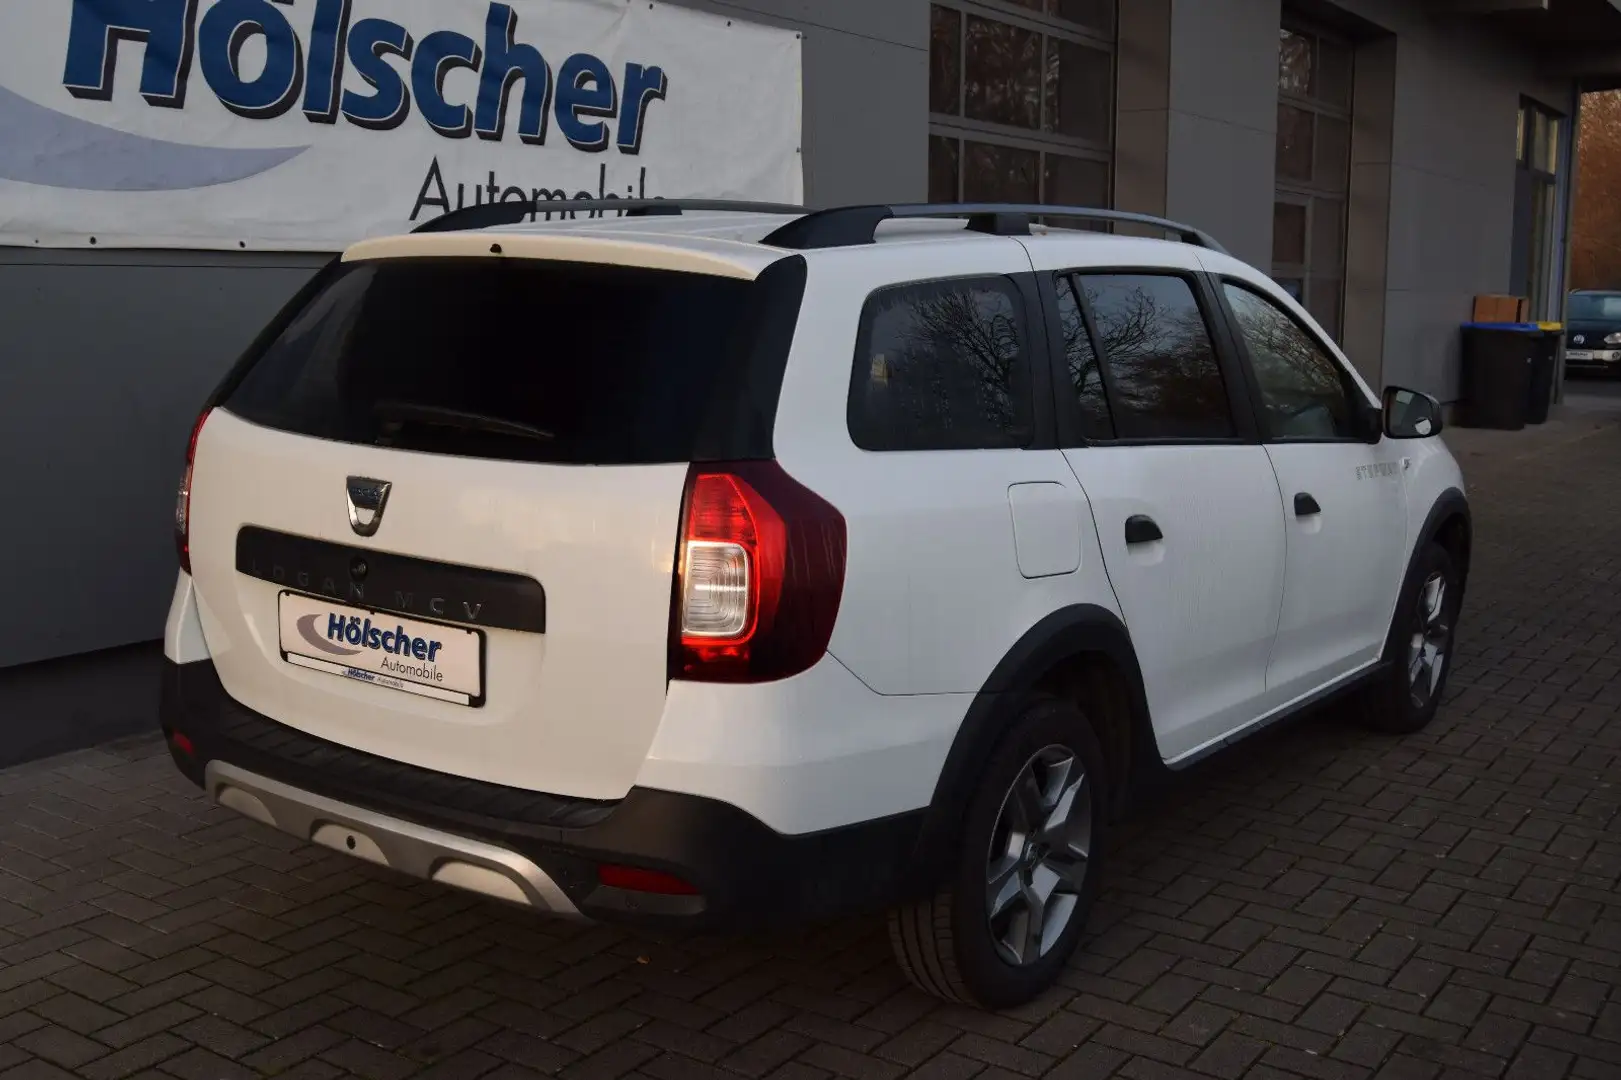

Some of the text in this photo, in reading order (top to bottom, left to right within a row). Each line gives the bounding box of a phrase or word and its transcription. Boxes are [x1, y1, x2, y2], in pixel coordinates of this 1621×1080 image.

[63, 0, 668, 154] Hölscher
[252, 558, 482, 620] LOGAN MCV
[327, 611, 443, 662] Hölscher
[347, 667, 375, 681] Hölscher
[380, 656, 444, 683] Automobile
